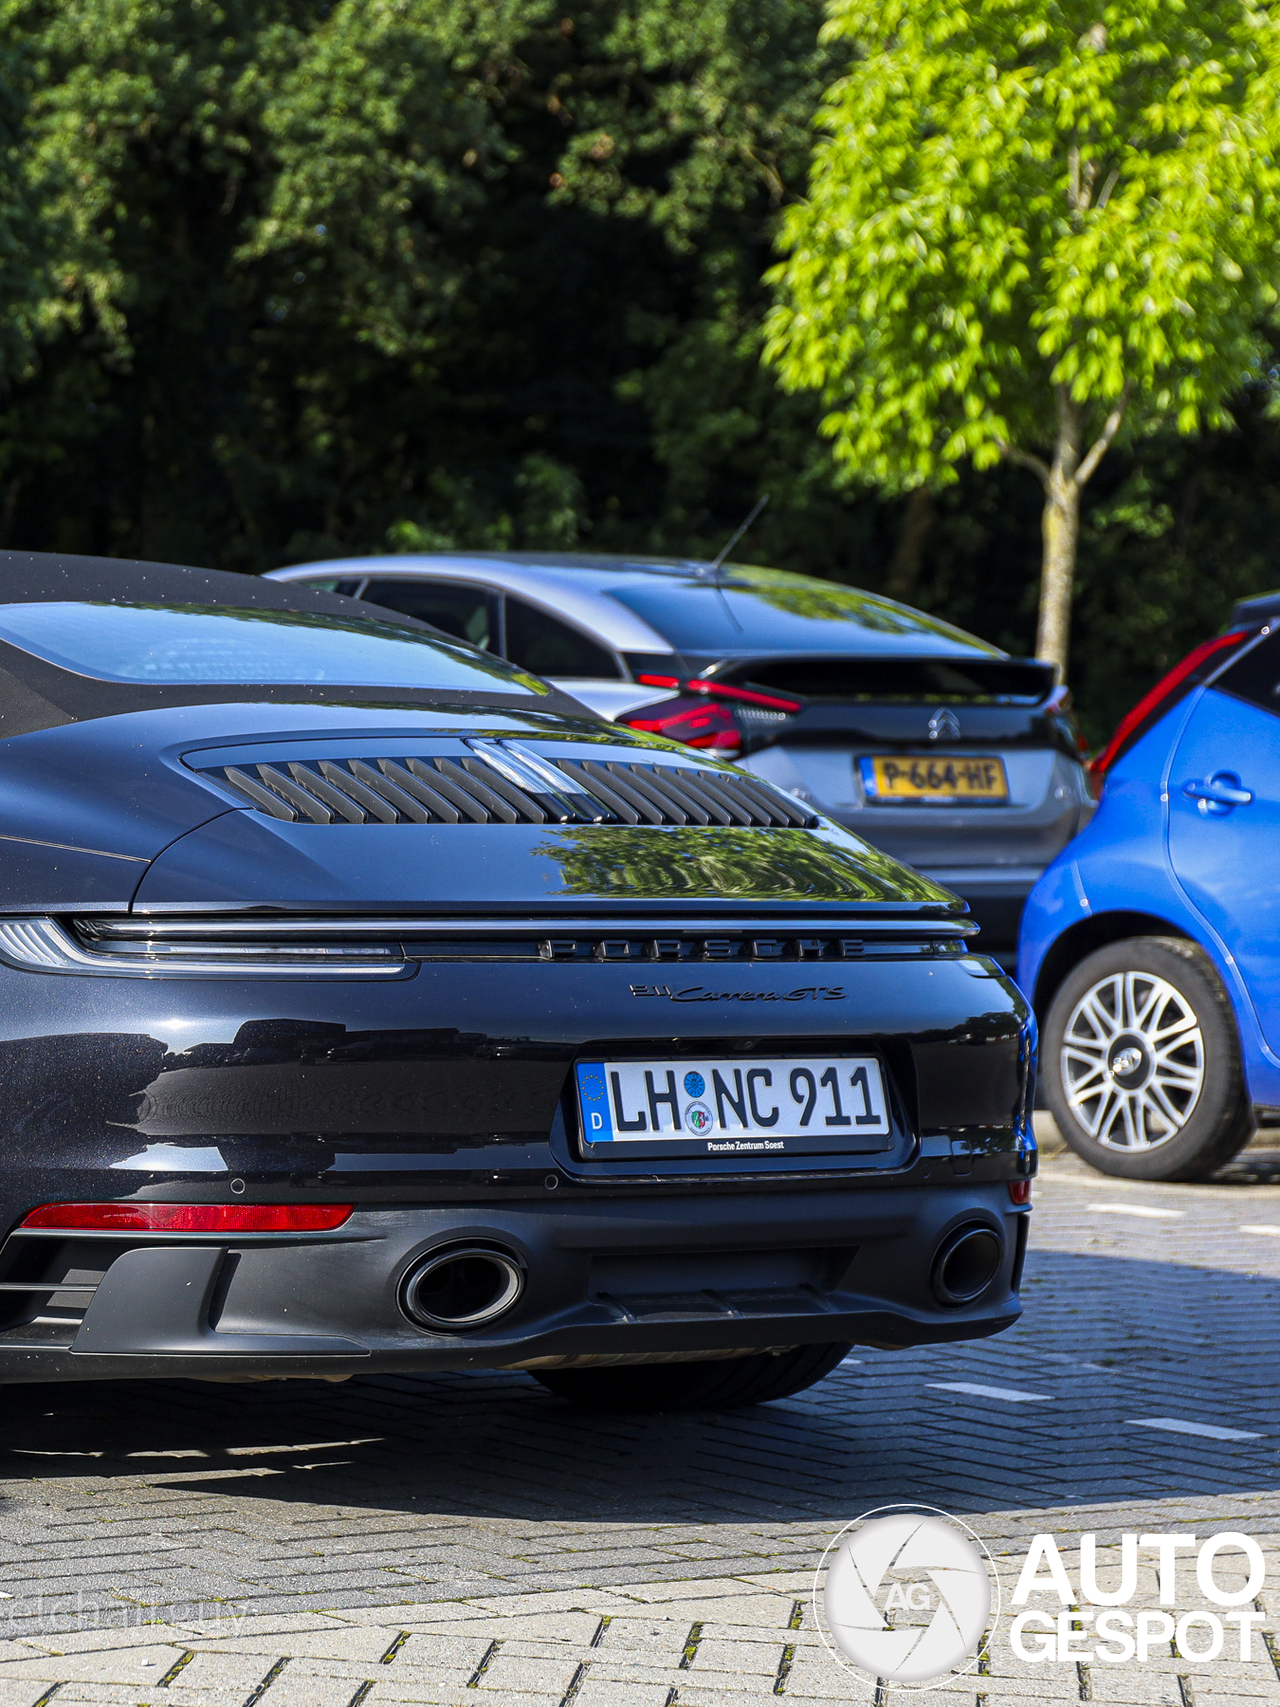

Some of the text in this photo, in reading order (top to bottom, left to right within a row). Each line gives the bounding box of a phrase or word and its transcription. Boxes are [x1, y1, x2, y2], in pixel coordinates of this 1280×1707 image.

[883, 761, 998, 790] P-664-HF
[540, 939, 865, 960] PORSCHE
[670, 986, 780, 1003] Carrera
[782, 986, 848, 1001] GTS
[609, 1069, 682, 1132] LH
[712, 1067, 780, 1130] NC
[789, 1066, 882, 1128] 911
[591, 1112, 603, 1130] D
[707, 1140, 784, 1151] Porsche Zentrum Soest
